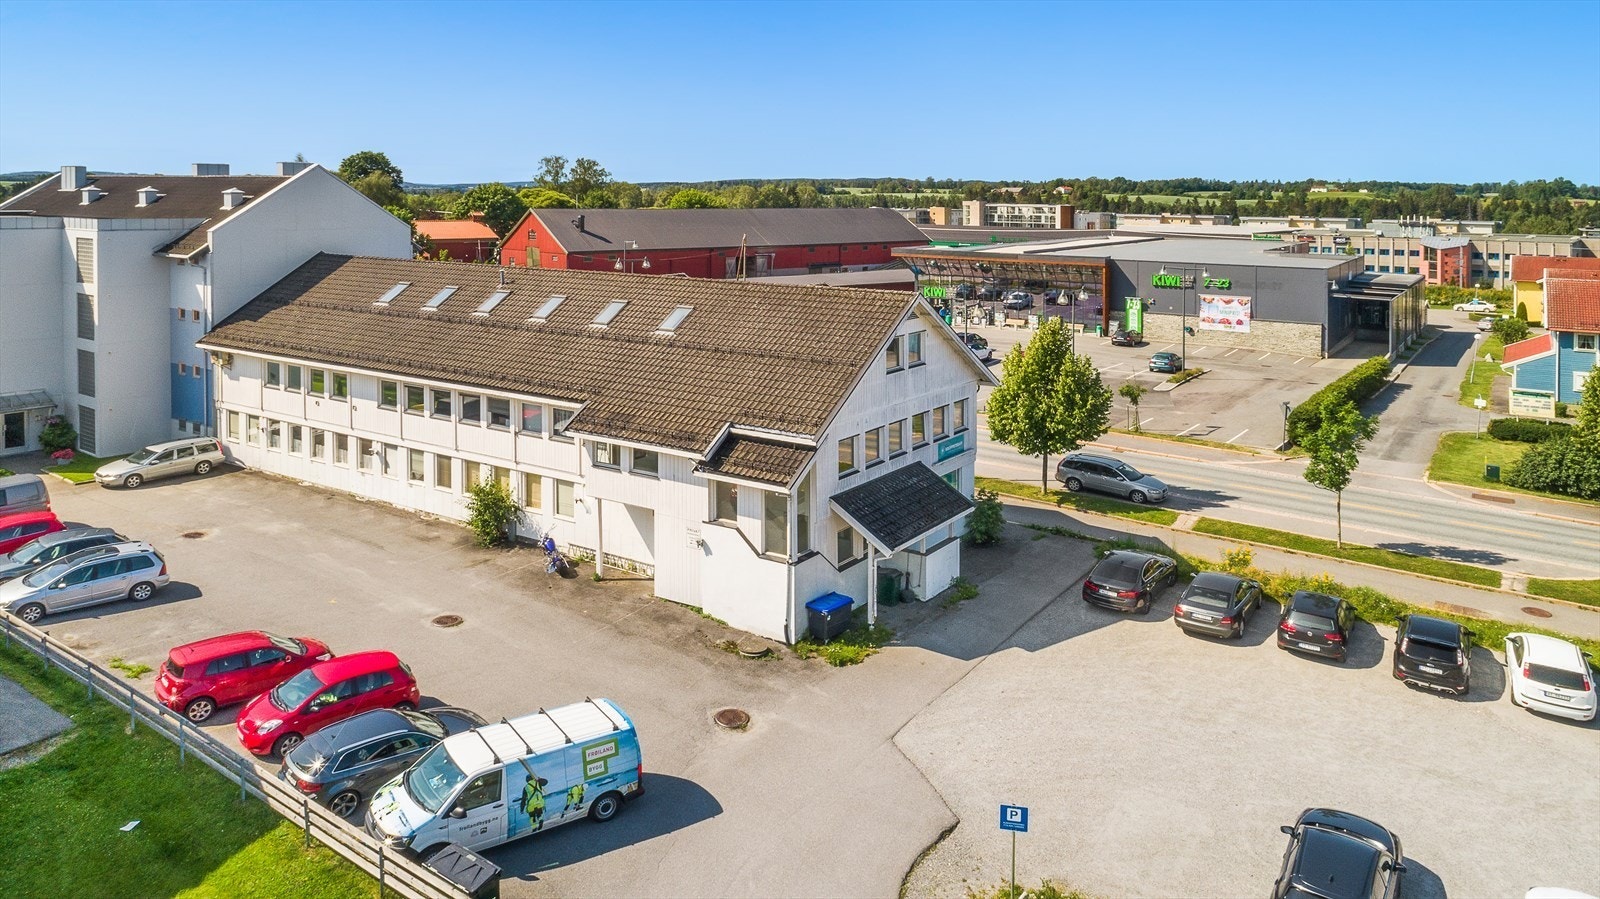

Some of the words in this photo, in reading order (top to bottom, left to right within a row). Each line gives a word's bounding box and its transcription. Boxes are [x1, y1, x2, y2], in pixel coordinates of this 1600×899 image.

[1152, 275, 1181, 286] KIWI
[923, 286, 946, 298] KIWI
[587, 745, 613, 758] FRØILAND
[588, 764, 602, 772] BYGG
[1010, 810, 1018, 819] P
